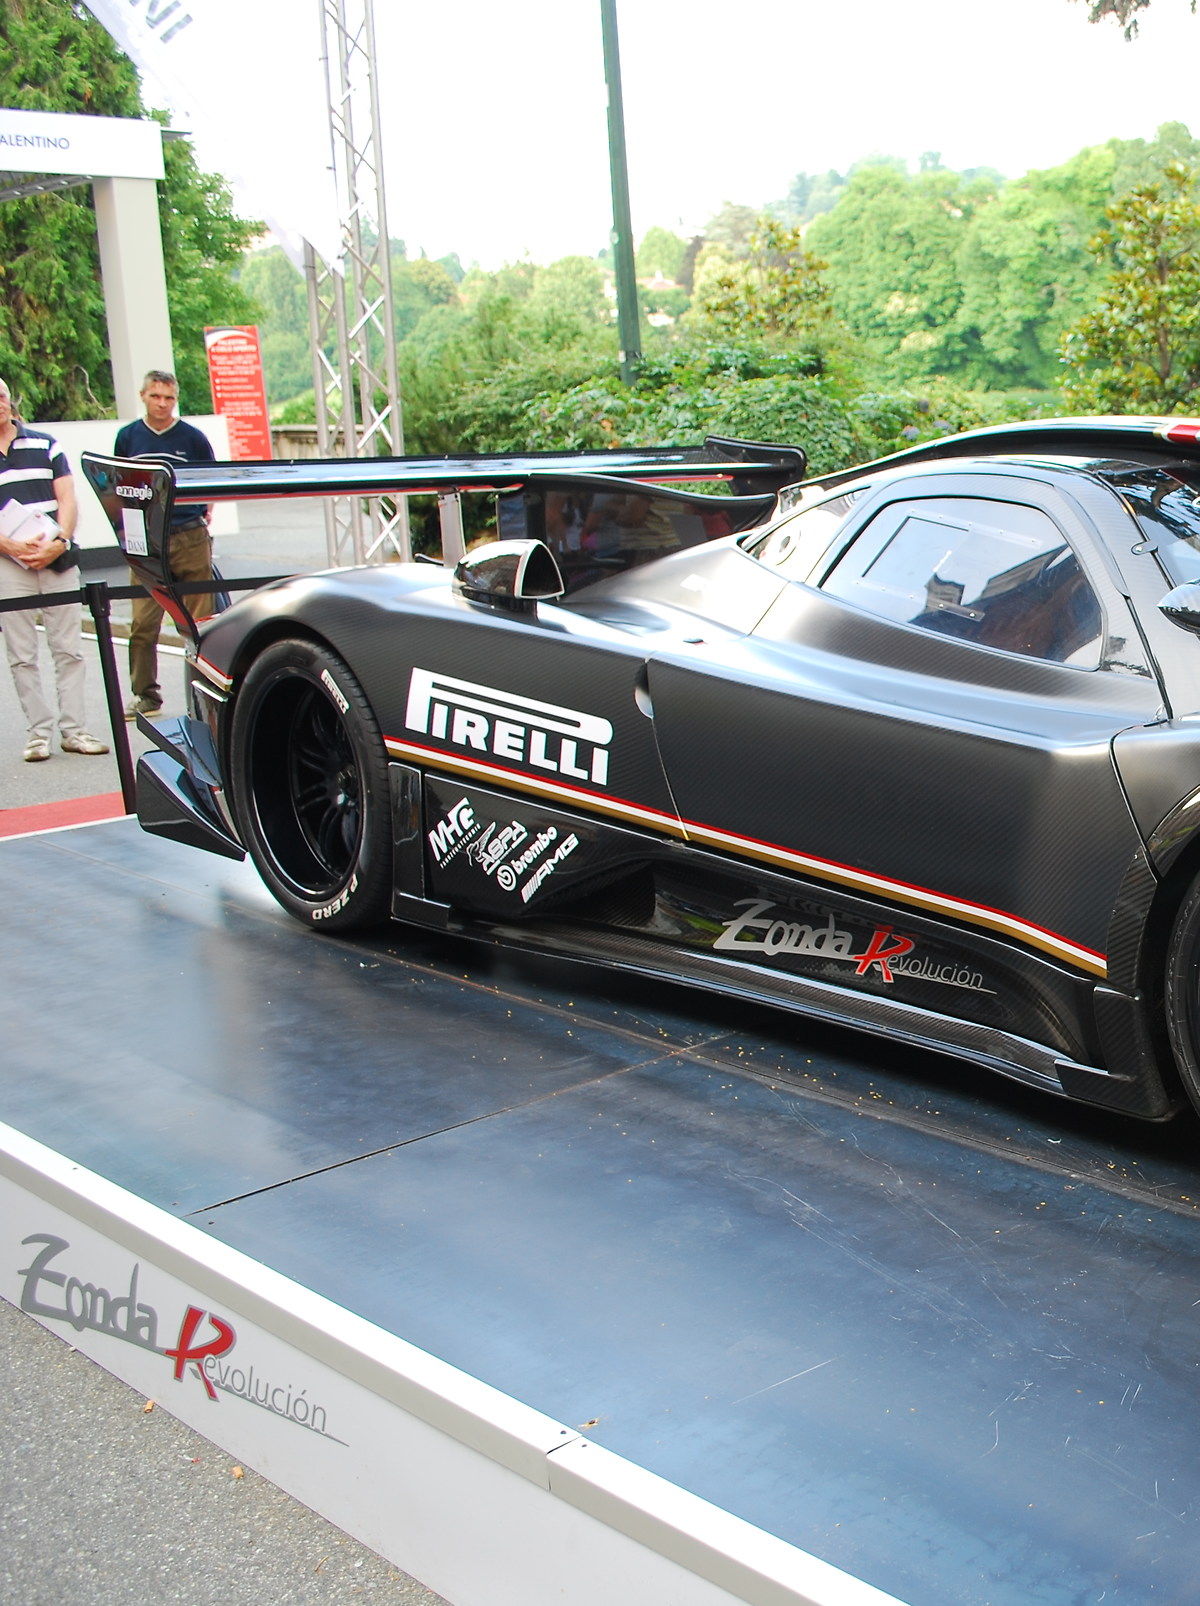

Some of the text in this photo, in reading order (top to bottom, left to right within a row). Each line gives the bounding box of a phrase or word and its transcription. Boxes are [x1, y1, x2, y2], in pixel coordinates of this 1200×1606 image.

[321, 668, 350, 715] PIRELLI
[405, 667, 614, 786] PIRELLI
[510, 826, 557, 875] brembo
[312, 873, 358, 920] P ZERO
[713, 899, 855, 956] Zonda
[17, 1233, 158, 1349] Zonda
